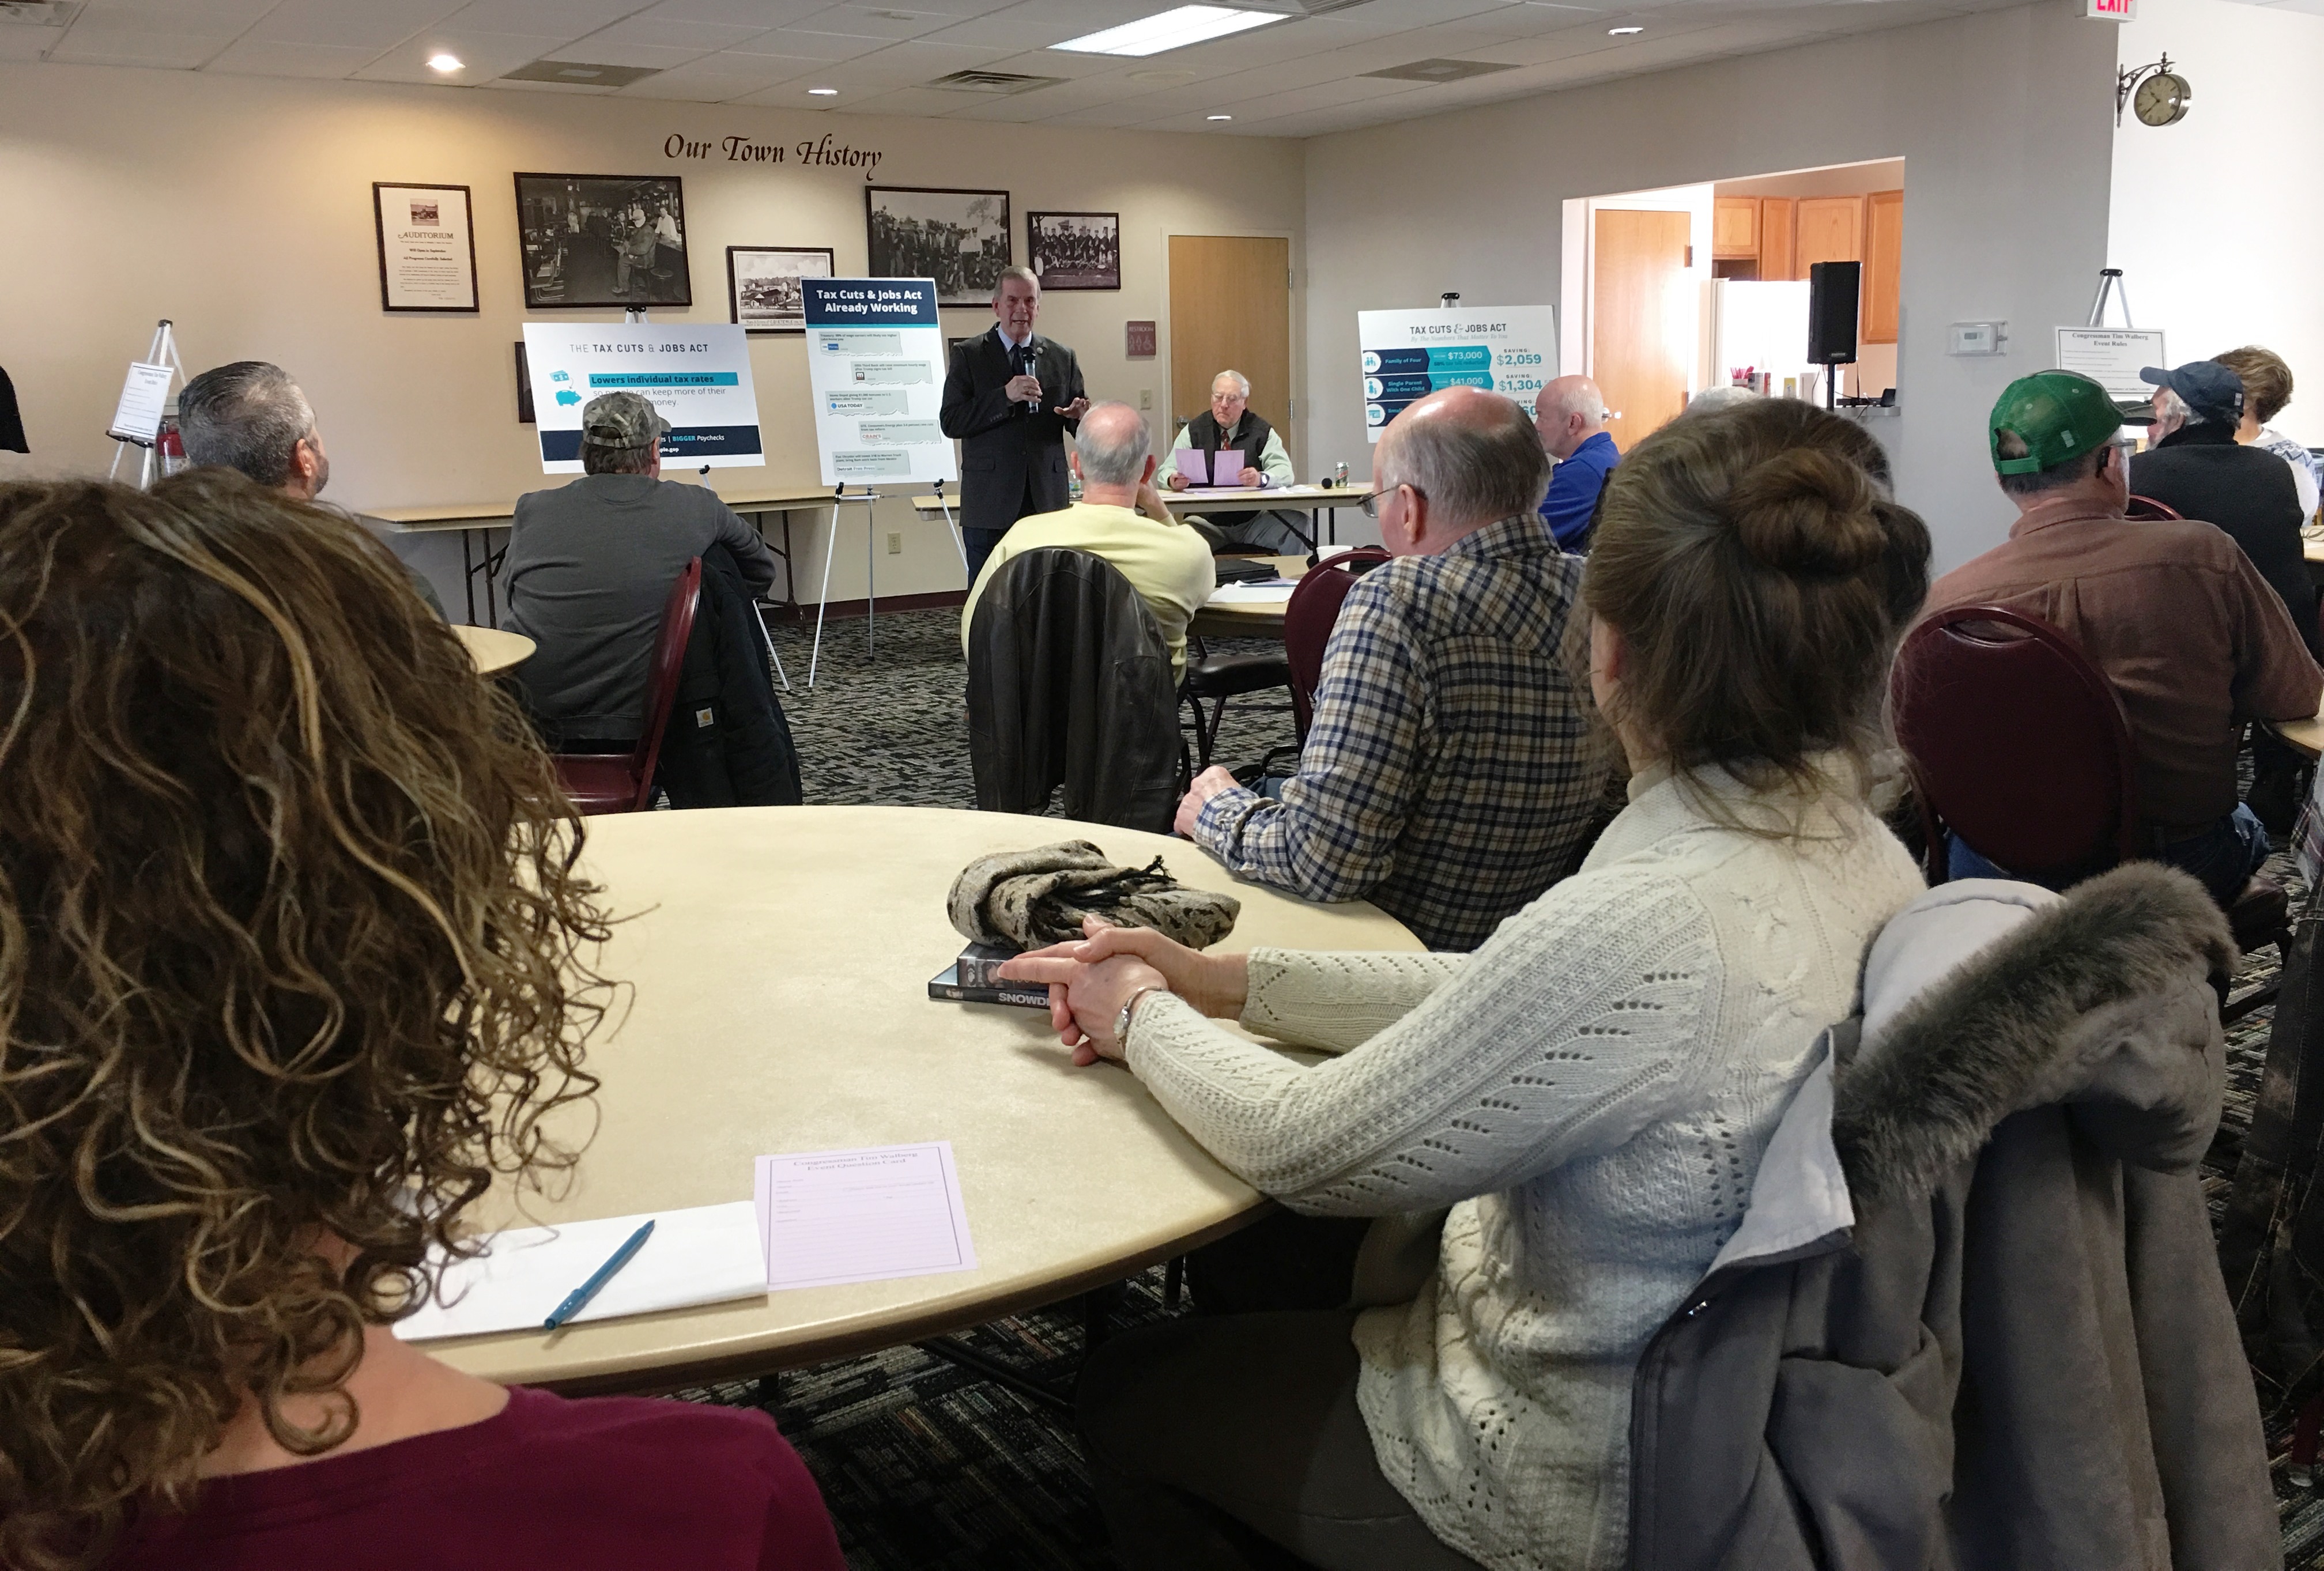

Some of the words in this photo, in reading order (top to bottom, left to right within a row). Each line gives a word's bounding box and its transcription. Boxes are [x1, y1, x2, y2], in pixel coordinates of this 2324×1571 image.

[664, 134, 712, 159] Our
[722, 135, 785, 163] Town
[797, 133, 882, 182] History
[816, 290, 837, 299] Tax
[840, 290, 865, 299] Cuts
[867, 290, 876, 299] &
[877, 290, 901, 301] Jobs
[904, 290, 922, 300] Act
[825, 303, 868, 315] Already
[870, 303, 918, 315] Working
[1409, 326, 1426, 334] TAX
[1429, 325, 1451, 334] CUTS
[1454, 323, 1463, 334] &
[1465, 324, 1488, 333] JOBS
[1490, 323, 1506, 331] ACT
[569, 344, 589, 352] THE
[593, 344, 613, 352] TAX
[617, 344, 644, 352] CUTS
[648, 344, 655, 352] &
[659, 344, 685, 352] JOBS
[689, 344, 708, 352] ACT
[1448, 352, 1482, 360] $73,000
[1497, 354, 1541, 367] $2,059
[627, 375, 672, 383] individual
[1450, 377, 1484, 386] $41,000
[1499, 380, 1542, 392] $1,304
[652, 388, 672, 397] keep
[793, 1157, 857, 1166] Congressman
[837, 1160, 880, 1169] Question
